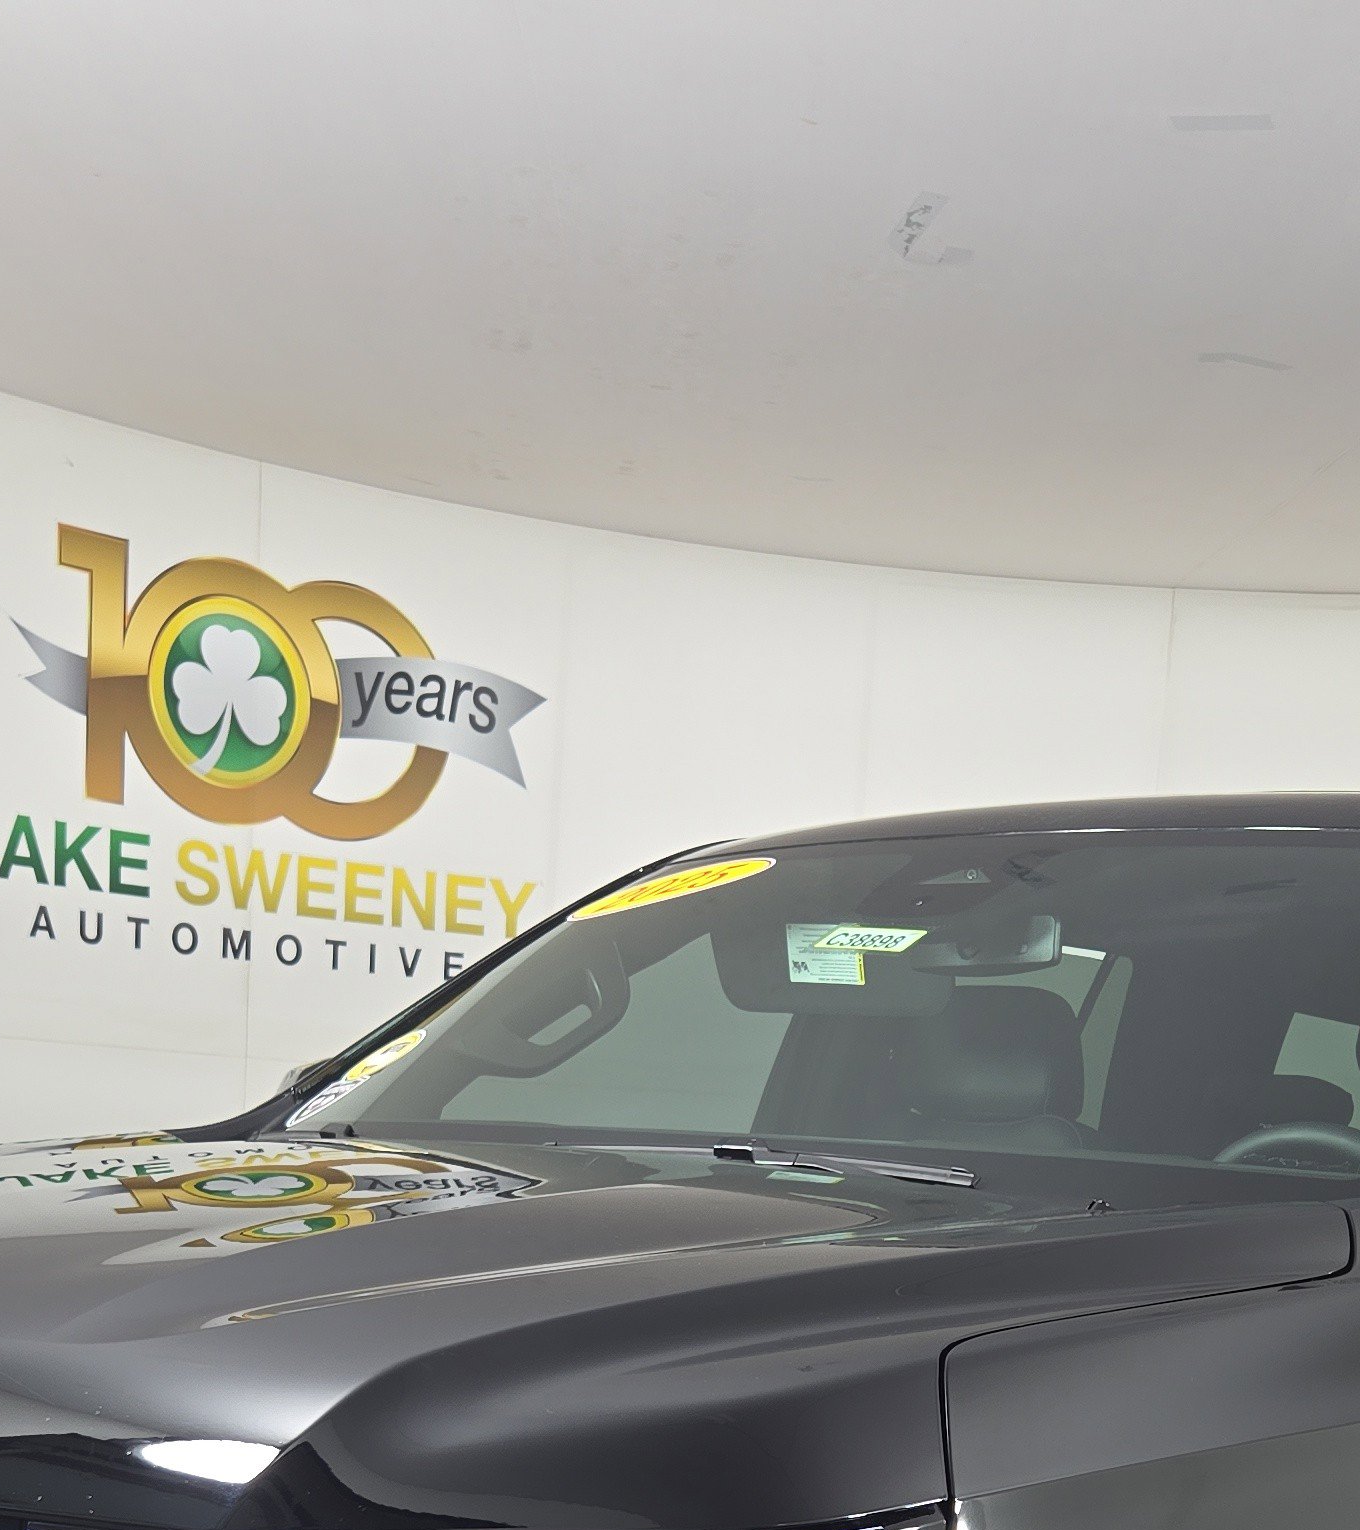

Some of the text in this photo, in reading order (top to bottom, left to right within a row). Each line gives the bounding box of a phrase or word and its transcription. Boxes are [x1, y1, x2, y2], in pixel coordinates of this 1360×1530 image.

[57, 521, 501, 842] 100 years
[175, 839, 538, 941] SWEENEY
[28, 906, 467, 981] AUTOMOTIVE
[826, 932, 907, 949] C38898
